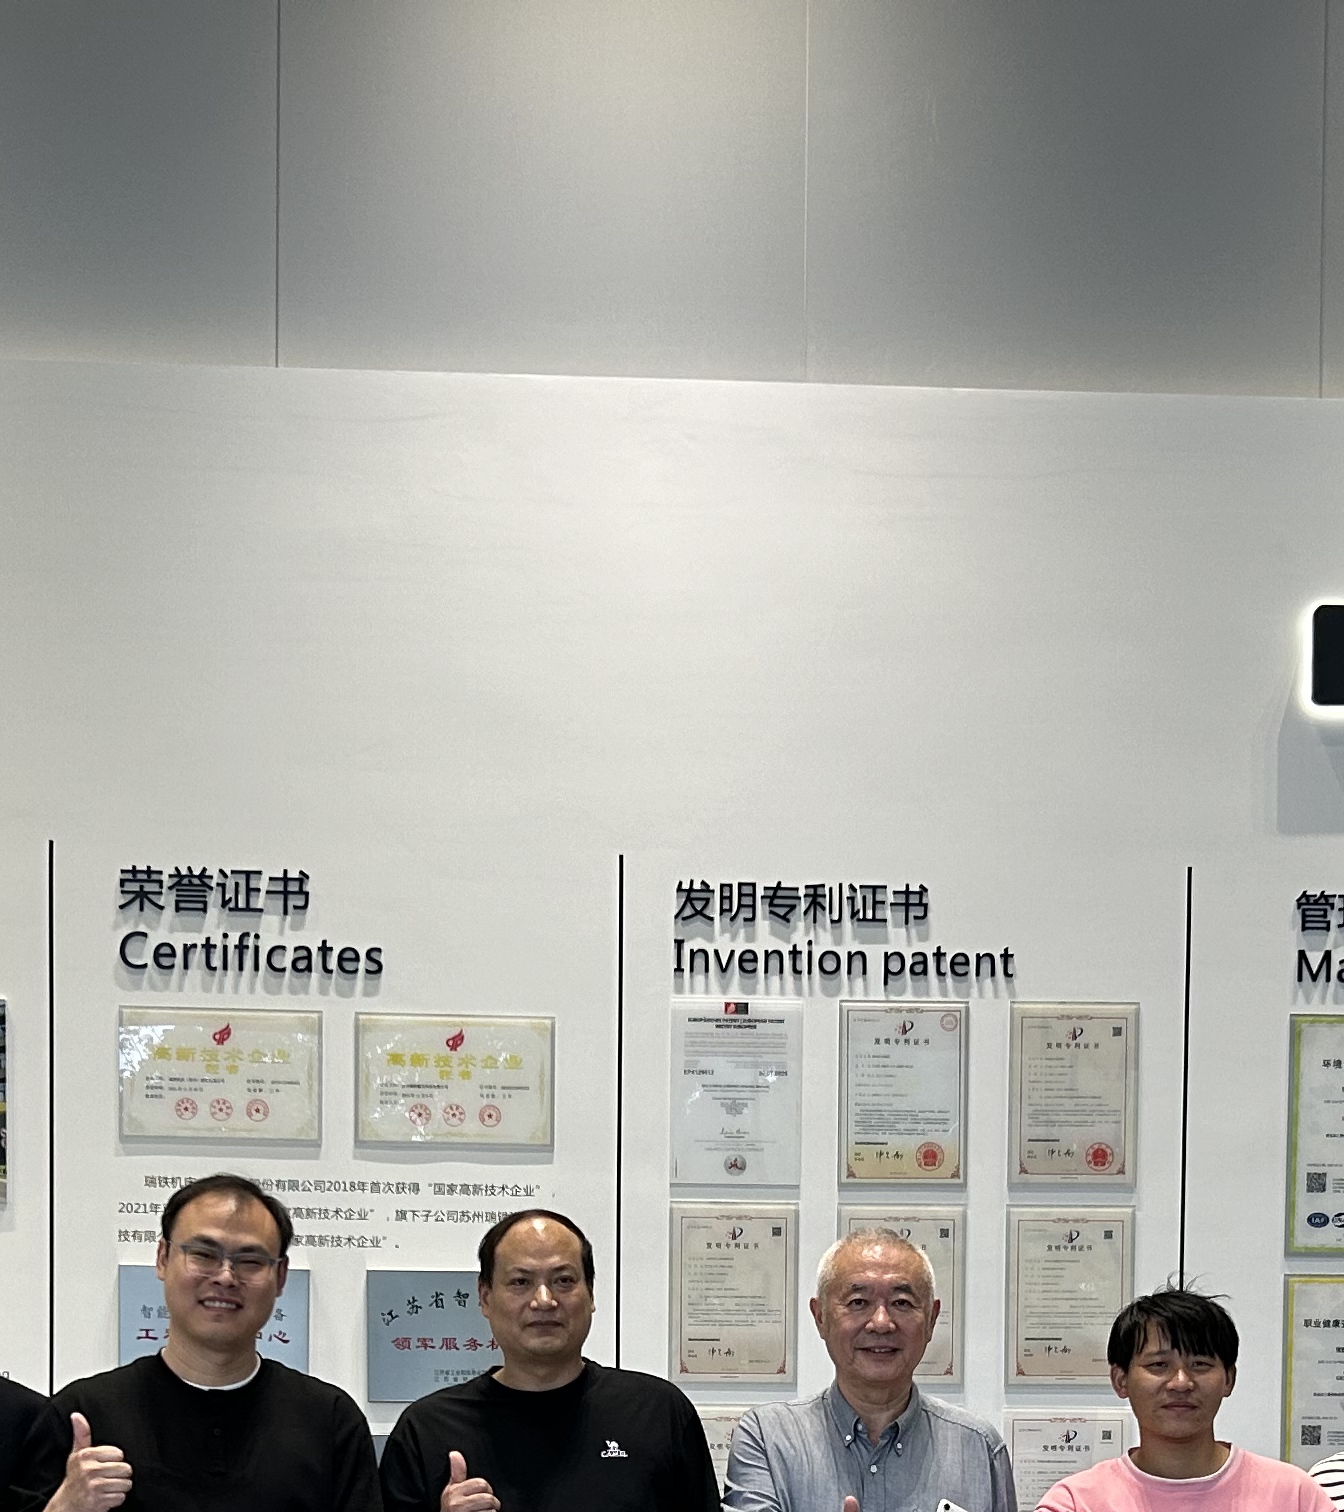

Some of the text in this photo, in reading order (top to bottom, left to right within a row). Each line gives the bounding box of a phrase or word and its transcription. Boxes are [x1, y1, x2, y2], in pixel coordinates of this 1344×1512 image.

[118, 866, 310, 916] 荣誉证书
[674, 880, 930, 925] 发明专利证书
[119, 932, 383, 976] Certificates
[674, 939, 1015, 985] Invention patent
